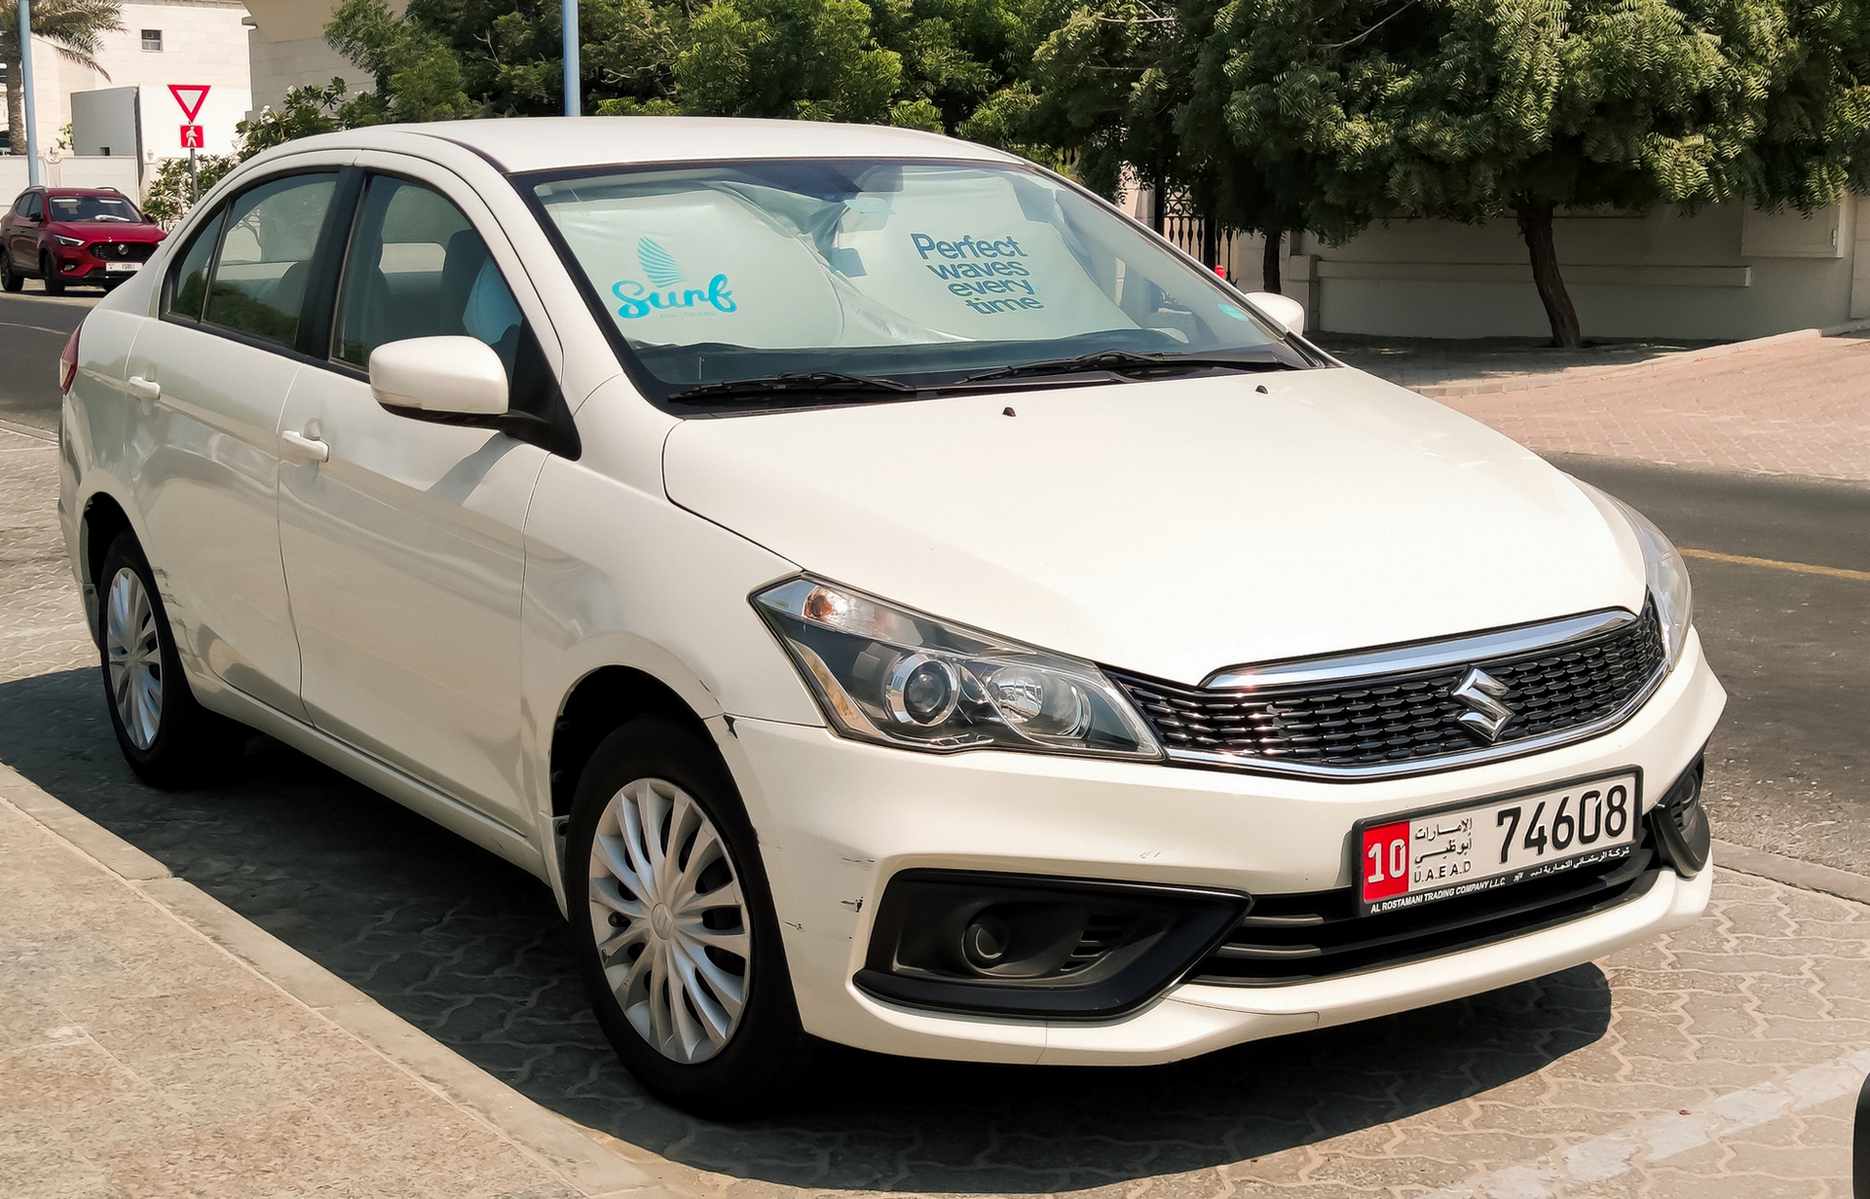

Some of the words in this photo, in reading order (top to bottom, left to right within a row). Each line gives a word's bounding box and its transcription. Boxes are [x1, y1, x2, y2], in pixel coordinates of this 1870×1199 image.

[911, 233, 1028, 259] Perfect
[926, 261, 1030, 280] waves
[612, 274, 737, 318] Surf
[947, 279, 1035, 297] every
[965, 298, 1044, 314] time
[1496, 785, 1627, 863] 74608
[1368, 838, 1406, 884] 10
[1370, 903, 1381, 914] AL
[1381, 894, 1424, 911] ROSTAMANI
[1423, 888, 1455, 902] TRADING
[1455, 880, 1490, 895] COMPANY
